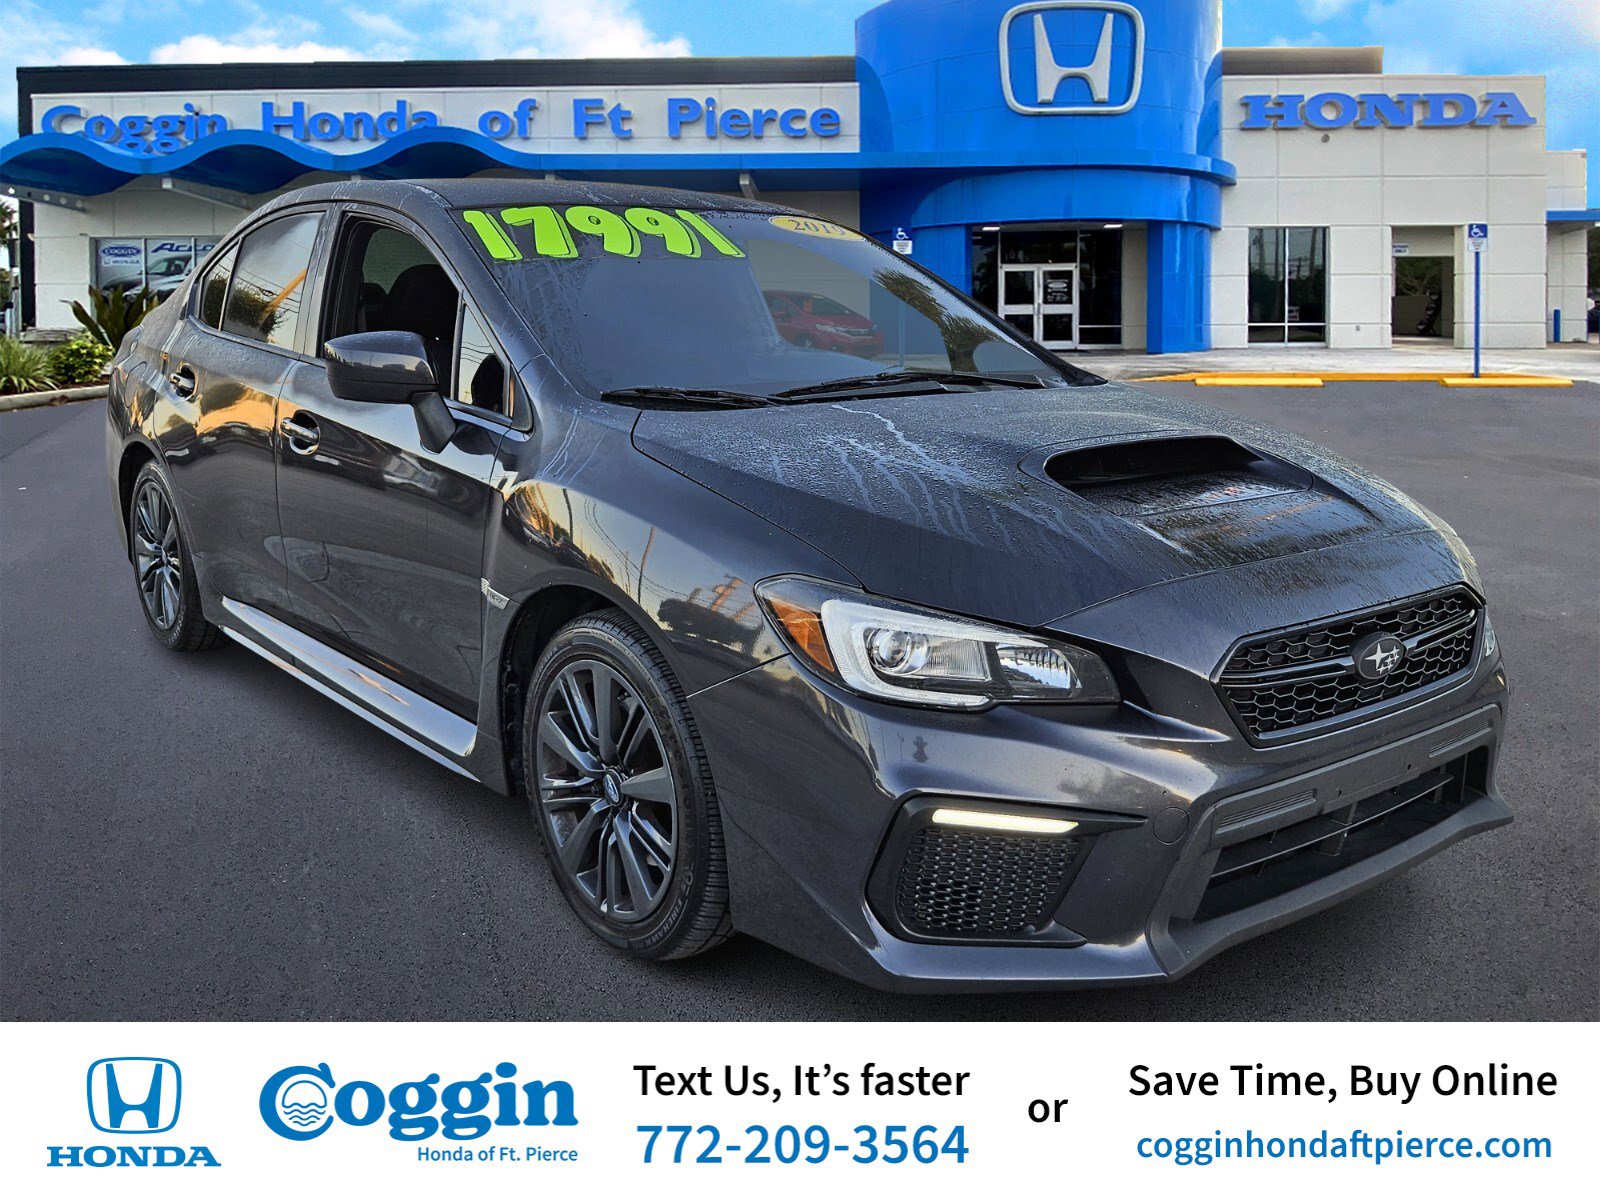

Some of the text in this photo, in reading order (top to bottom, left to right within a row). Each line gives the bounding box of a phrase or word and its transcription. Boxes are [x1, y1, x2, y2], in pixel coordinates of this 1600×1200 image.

[41, 97, 842, 154] Coggin Honda of Ft Pierce
[1240, 92, 1538, 130] HONDA
[462, 205, 747, 261] 17991
[643, 897, 684, 948] FIREHAWK
